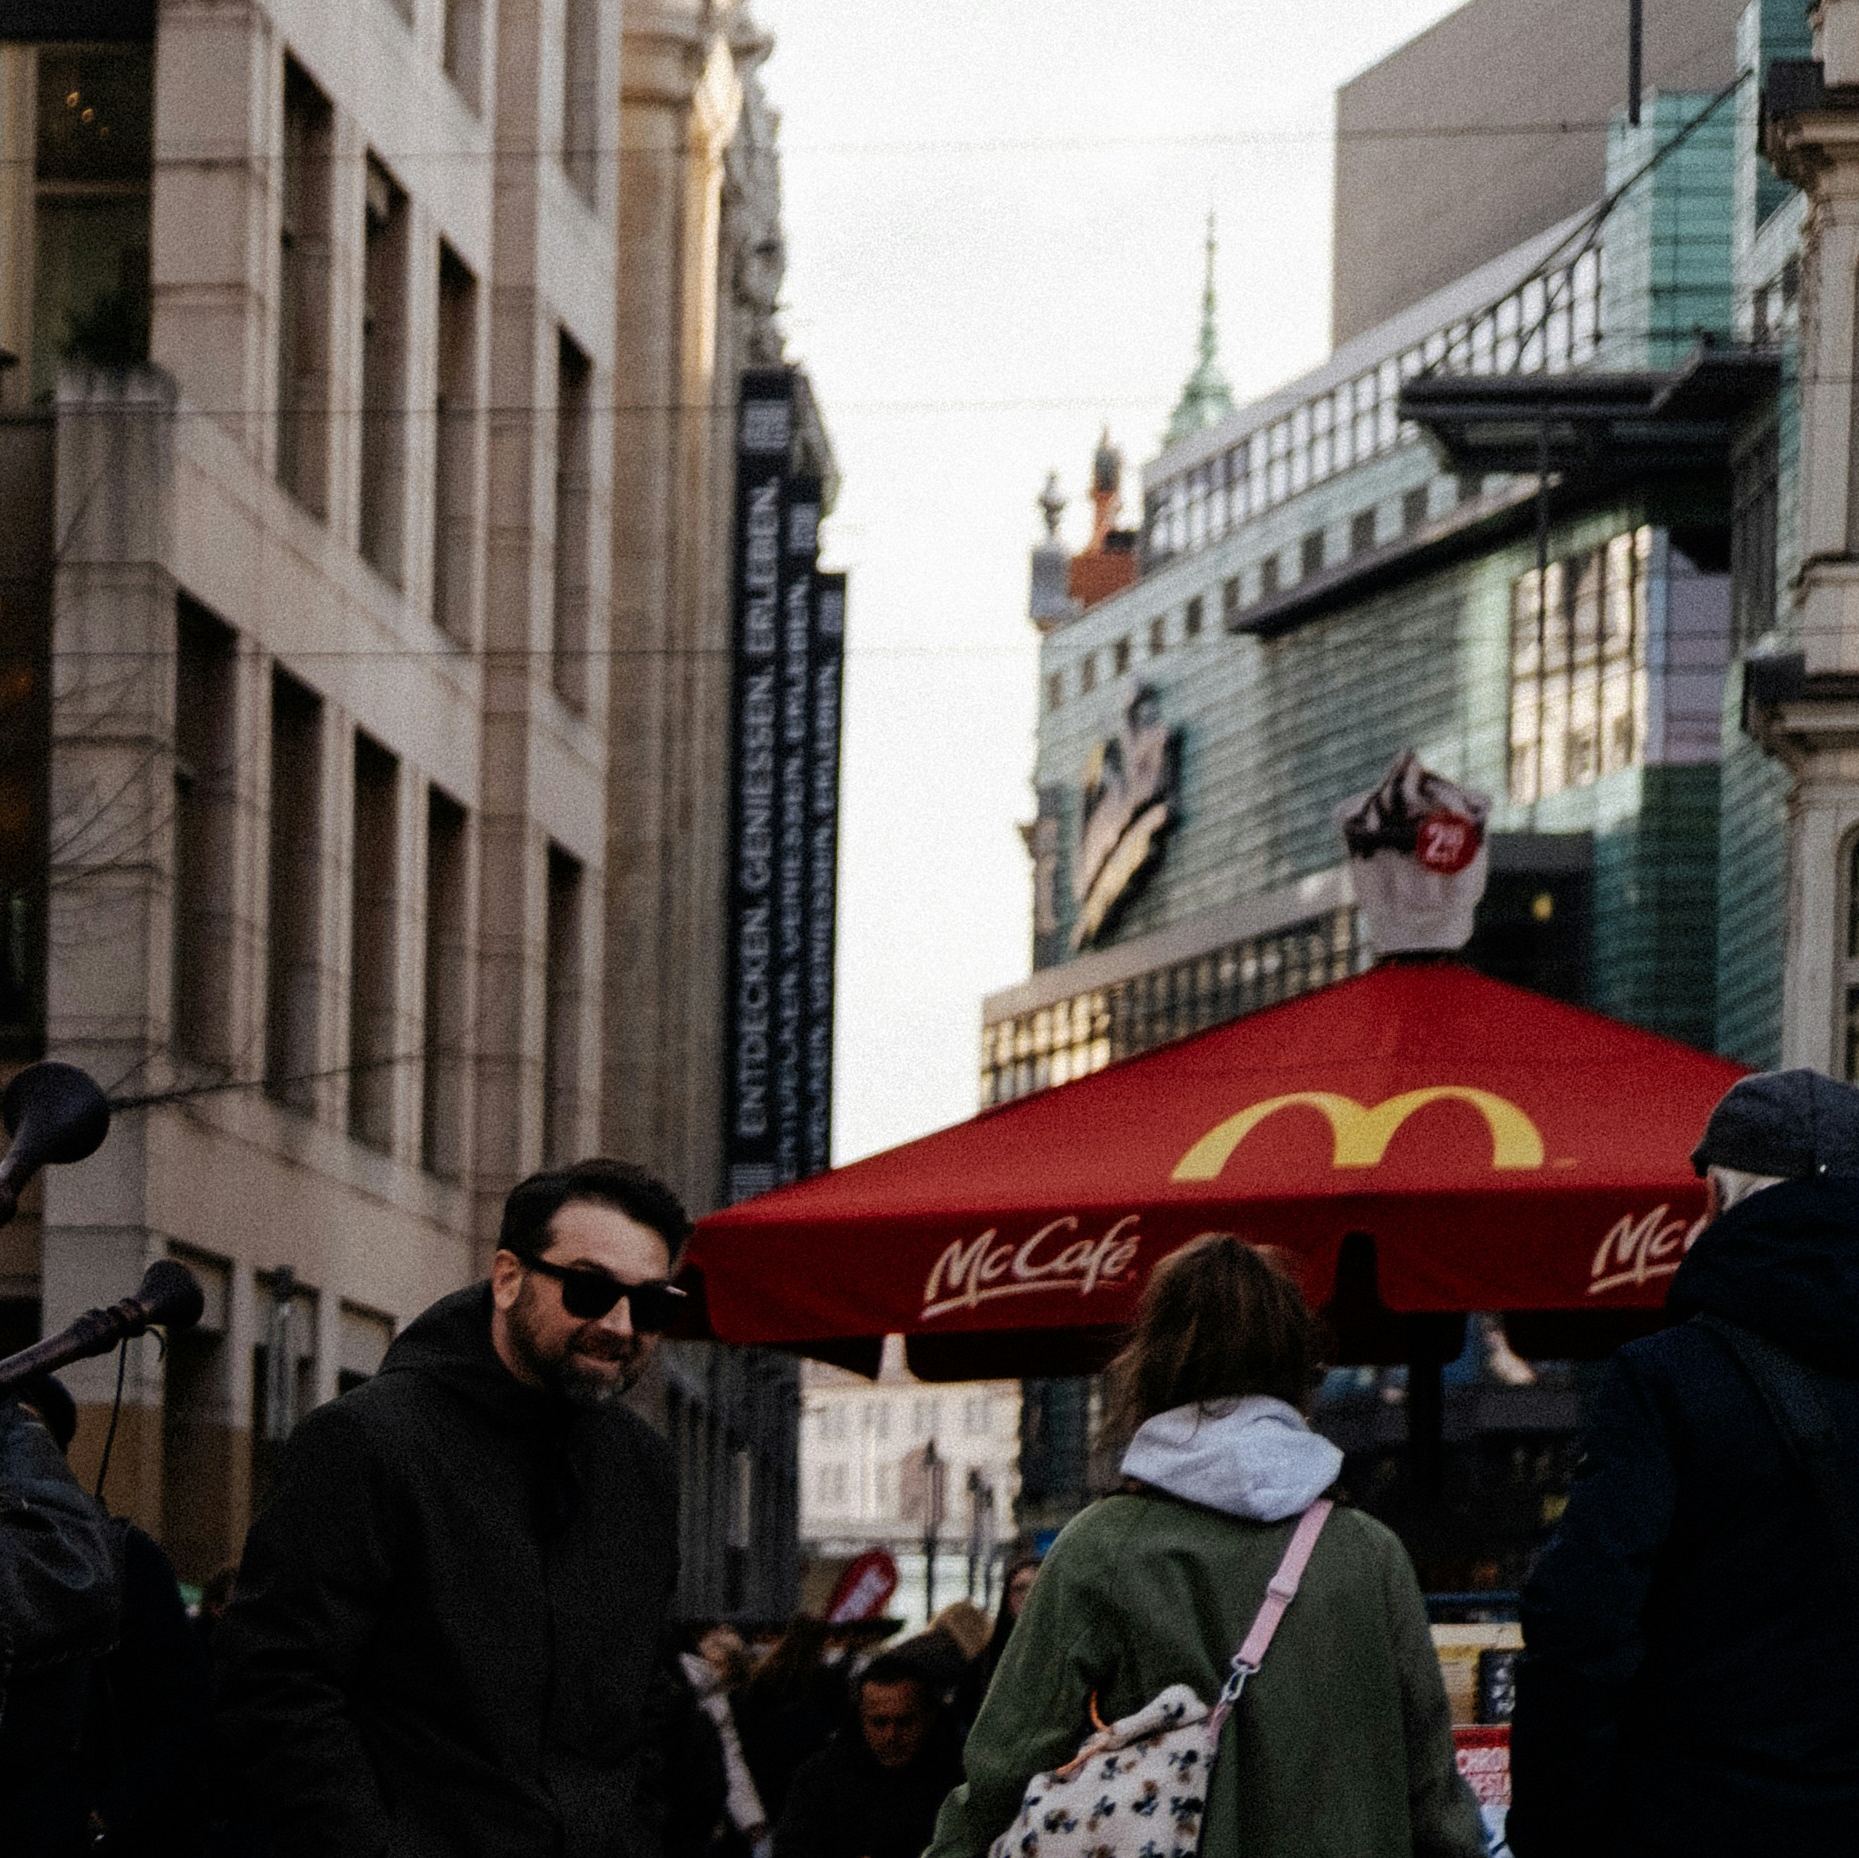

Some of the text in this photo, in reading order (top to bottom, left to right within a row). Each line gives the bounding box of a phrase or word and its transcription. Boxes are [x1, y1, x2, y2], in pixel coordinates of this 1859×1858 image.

[744, 476, 779, 656] ERLEBEN.
[738, 664, 774, 893] GENIESSEN.
[736, 898, 771, 1138] ENTDECKEN.
[921, 1213, 1140, 1316] McCafé
